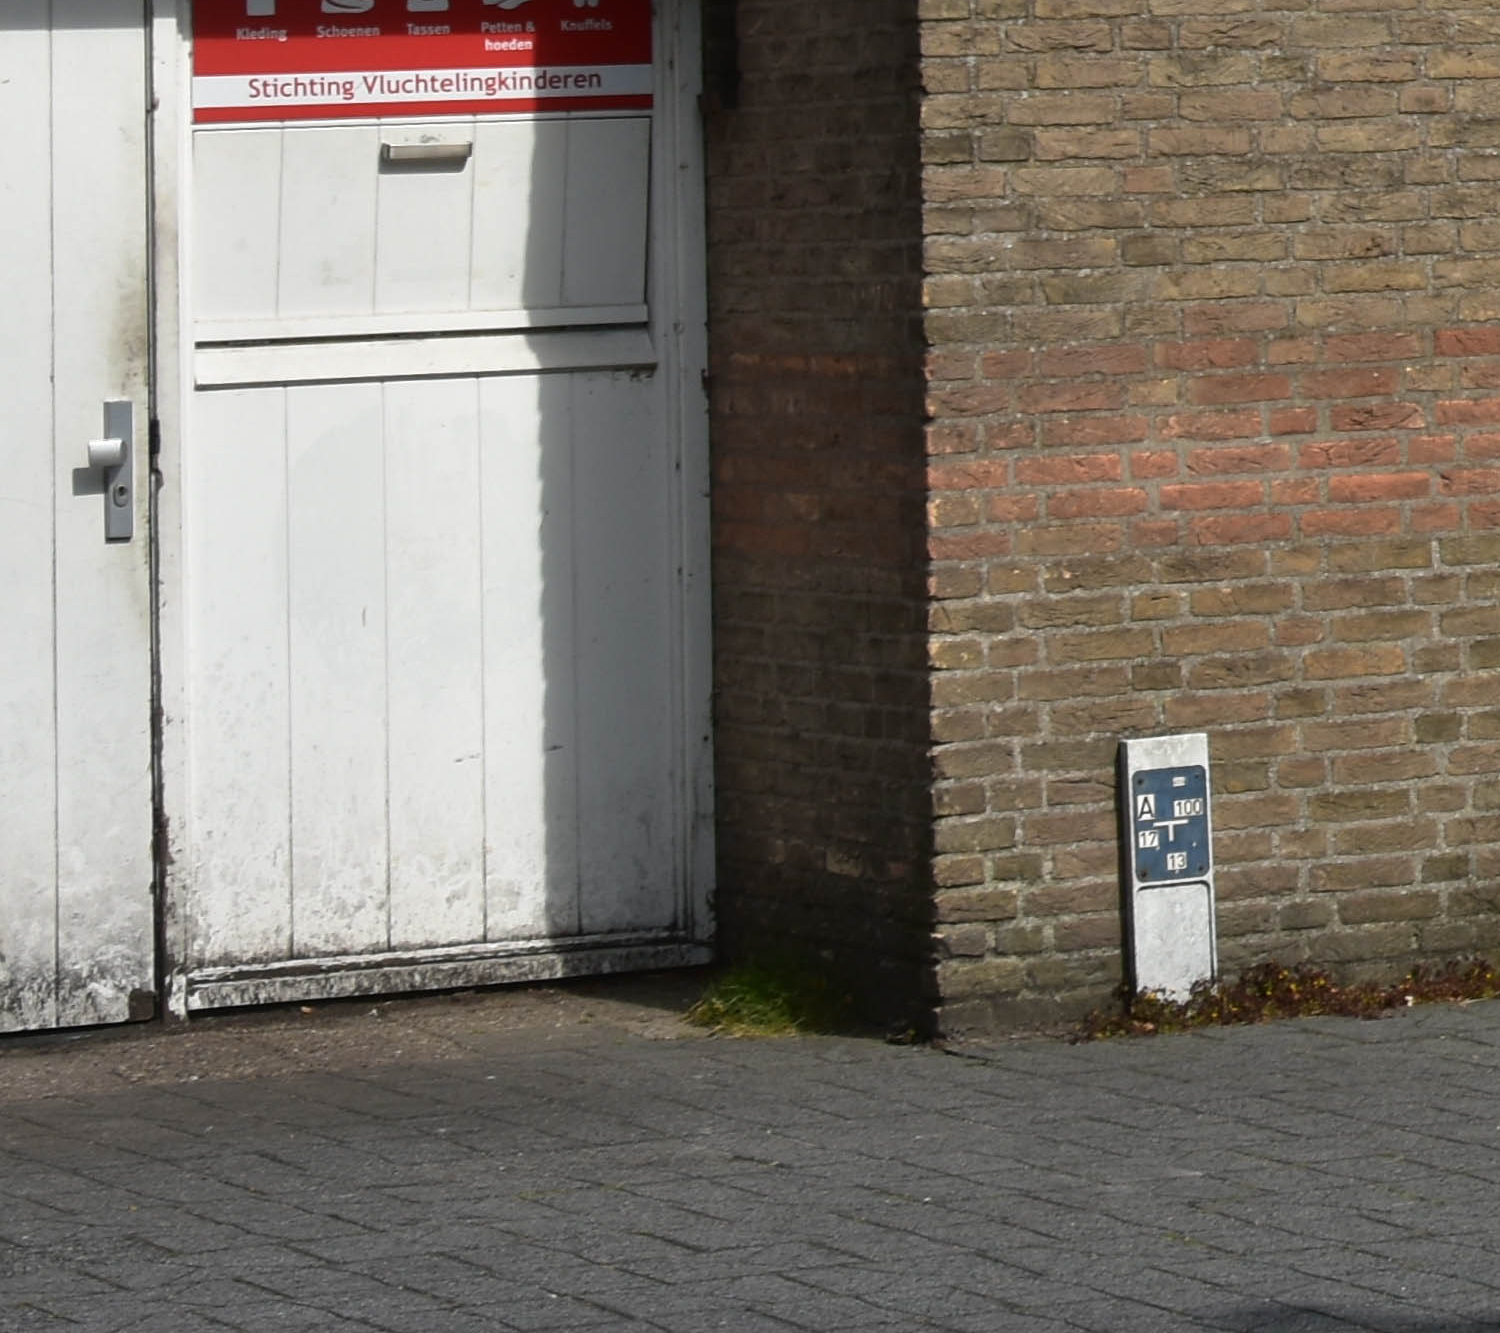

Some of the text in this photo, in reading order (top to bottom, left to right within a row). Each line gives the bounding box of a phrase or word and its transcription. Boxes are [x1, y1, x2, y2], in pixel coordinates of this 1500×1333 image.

[316, 23, 381, 40] Schoenen
[406, 21, 451, 36] Tassen
[480, 19, 535, 35] Petten &
[560, 16, 613, 33] Knuffels
[236, 26, 288, 43] Kleding
[485, 36, 534, 52] hoeden
[248, 68, 603, 101] Stichting Vluchtelingkinderen
[1139, 796, 1201, 818] A 100
[1169, 854, 1185, 869] 13
